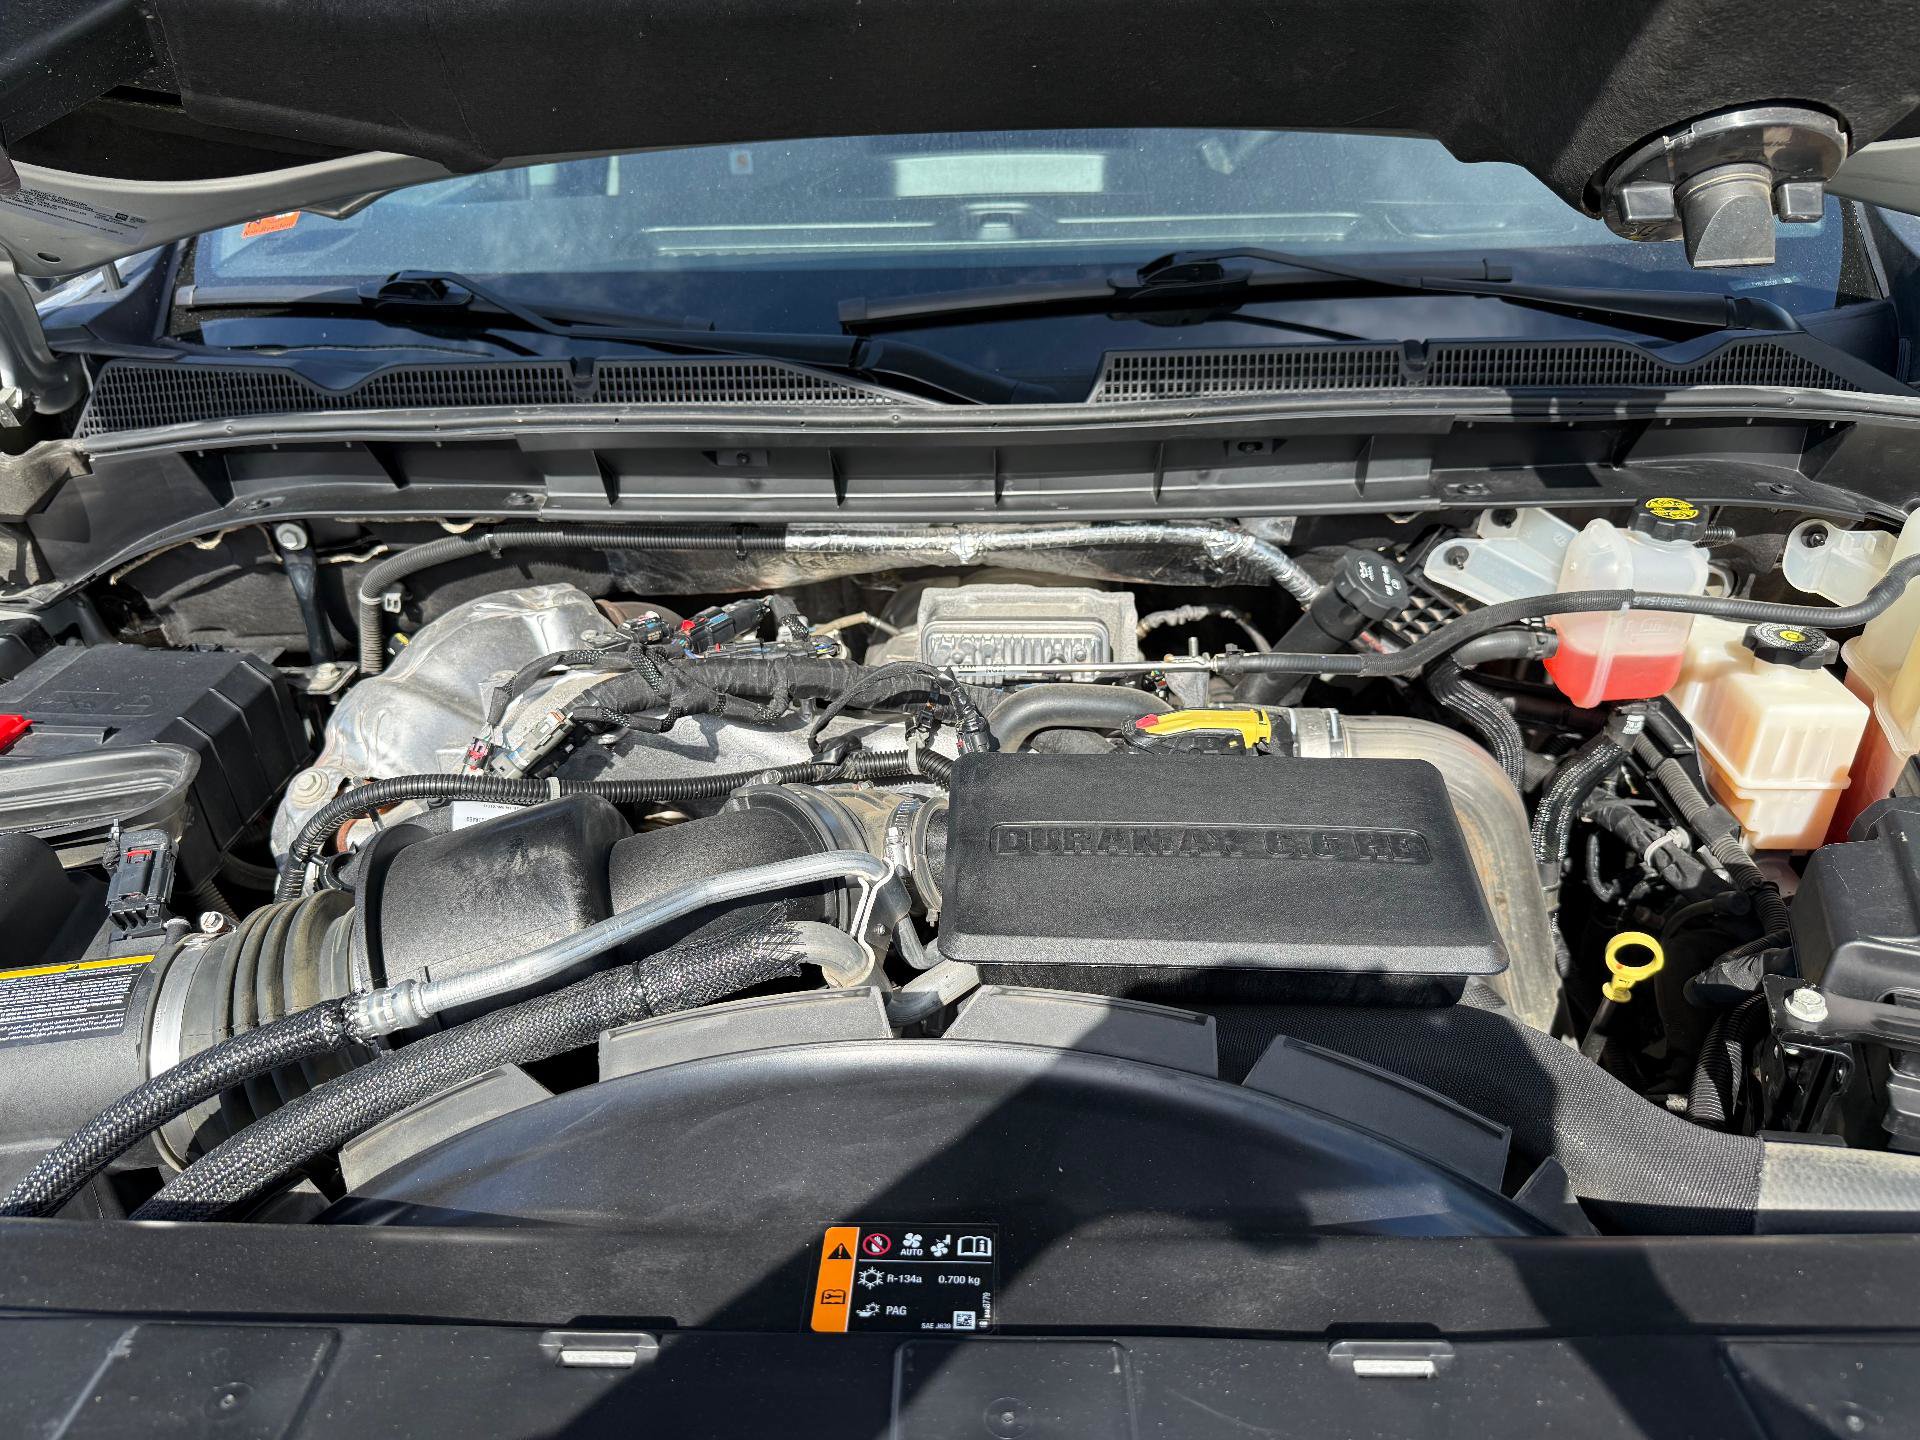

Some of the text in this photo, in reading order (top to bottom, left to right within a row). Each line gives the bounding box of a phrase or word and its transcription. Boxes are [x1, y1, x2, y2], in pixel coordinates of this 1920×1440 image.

[998, 828, 1246, 856] DURAMAX
[1352, 831, 1432, 864] HD
[900, 1248, 924, 1256] AUTO
[887, 1274, 981, 1287] R-134a 0.700 kg
[885, 1306, 908, 1315] PAG
